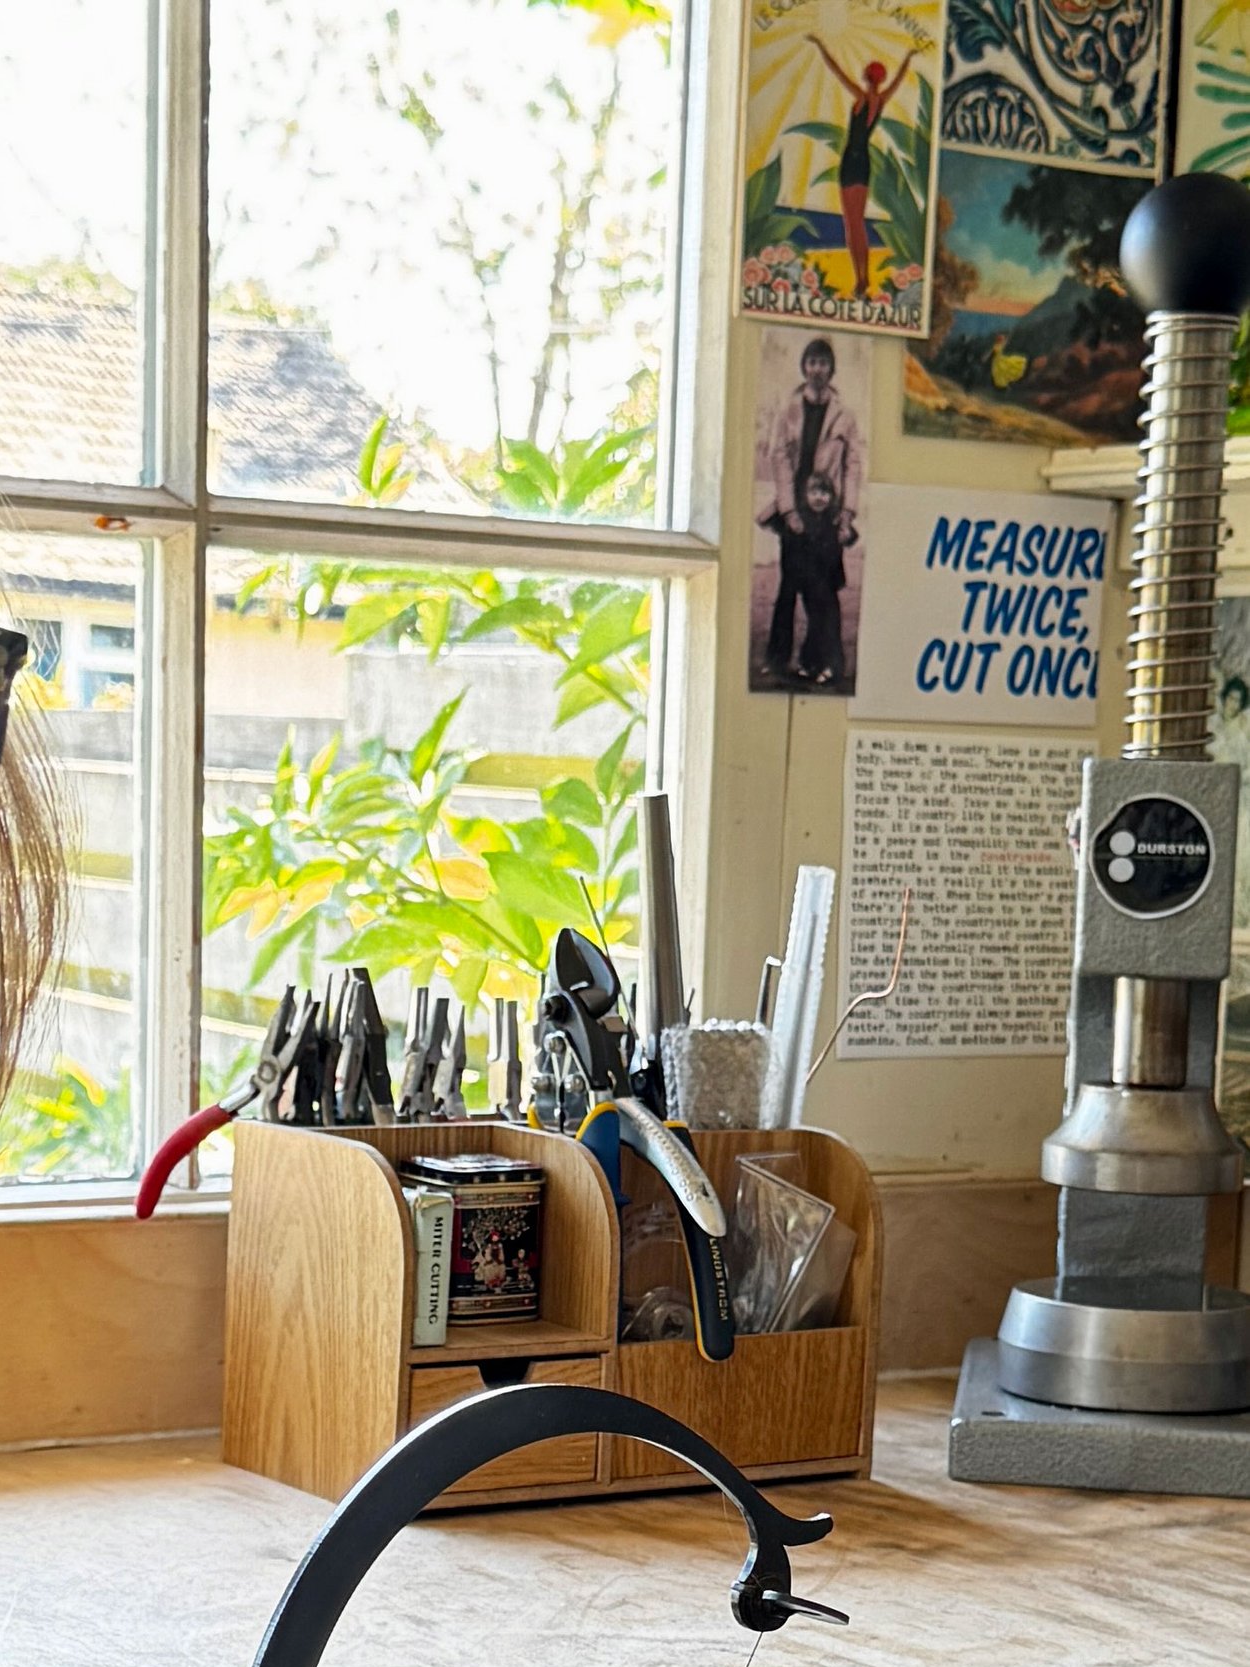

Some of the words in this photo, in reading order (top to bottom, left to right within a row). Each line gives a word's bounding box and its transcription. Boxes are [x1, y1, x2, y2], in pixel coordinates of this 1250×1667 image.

[742, 286, 778, 312] SUR
[781, 290, 804, 315] LA
[961, 580, 1090, 644] TWICE,
[916, 638, 1002, 694] CUT
[1137, 843, 1207, 856] DURSTON
[431, 1216, 444, 1258] MITER
[428, 1262, 441, 1325] CUTTING
